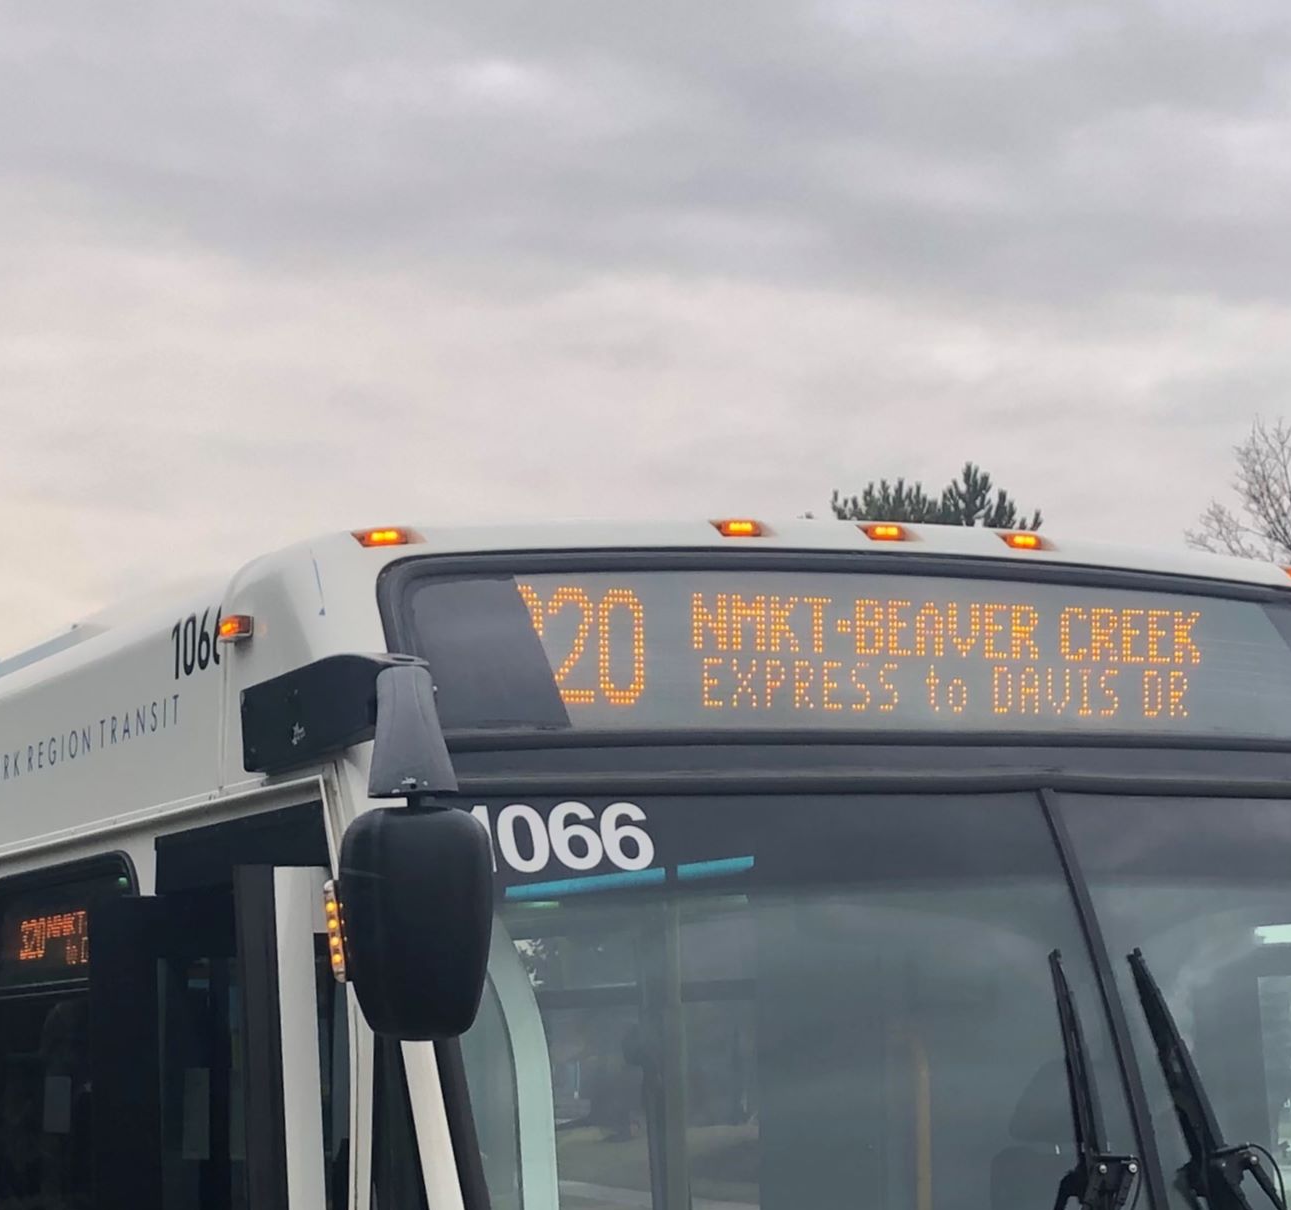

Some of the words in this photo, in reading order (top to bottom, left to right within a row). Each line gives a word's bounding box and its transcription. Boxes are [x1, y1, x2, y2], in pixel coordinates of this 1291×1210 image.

[692, 592, 1040, 660] NMKT-BEAVER
[1059, 606, 1201, 664] CREEK
[702, 657, 898, 709] EXPRESS
[925, 664, 967, 713] to
[993, 665, 1120, 715] DAVIS
[1143, 669, 1189, 717] DR
[27, 725, 92, 773] REGION
[99, 694, 180, 749] TRANSIT
